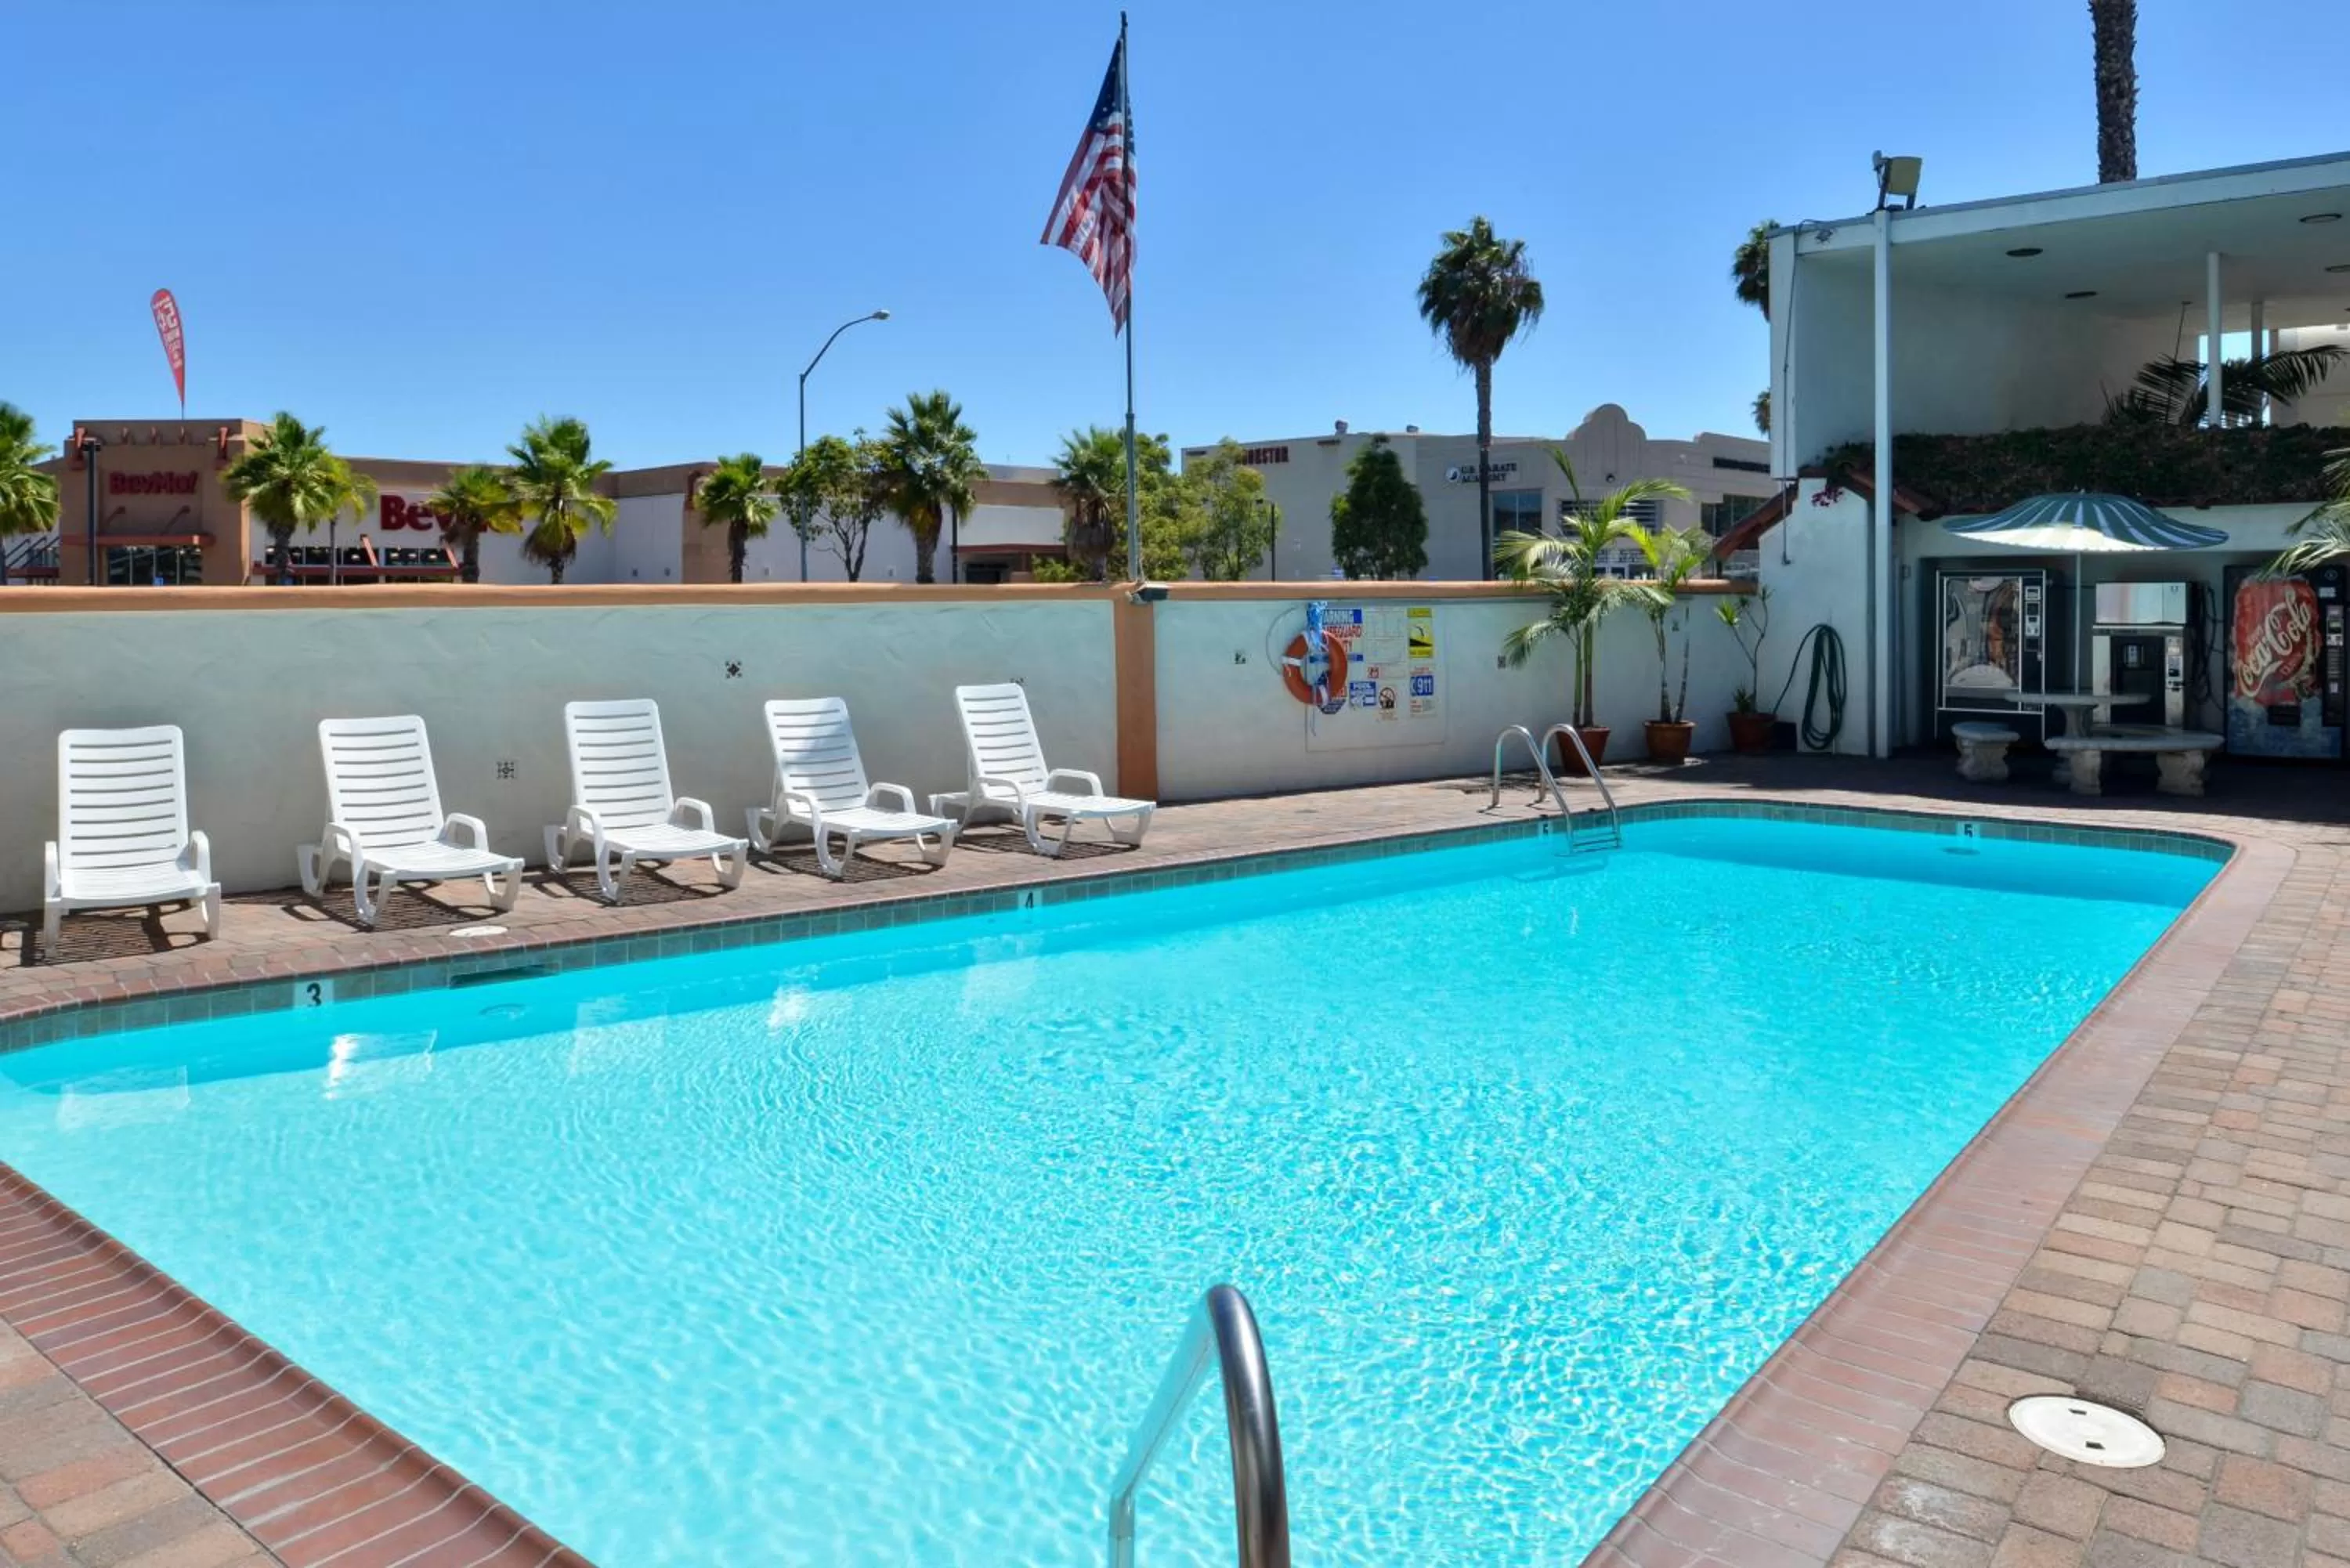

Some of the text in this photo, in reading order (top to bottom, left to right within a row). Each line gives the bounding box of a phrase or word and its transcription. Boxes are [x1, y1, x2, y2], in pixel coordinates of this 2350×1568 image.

[1480, 463, 1517, 472] ARATE
[110, 470, 199, 495] BevMo!
[1462, 473, 1506, 483] ACAEMY
[1323, 609, 1354, 623] ARNING
[1417, 677, 1432, 695] 911
[1965, 824, 1973, 839] 5
[1025, 891, 1033, 909] 4
[306, 982, 322, 1008] 3
